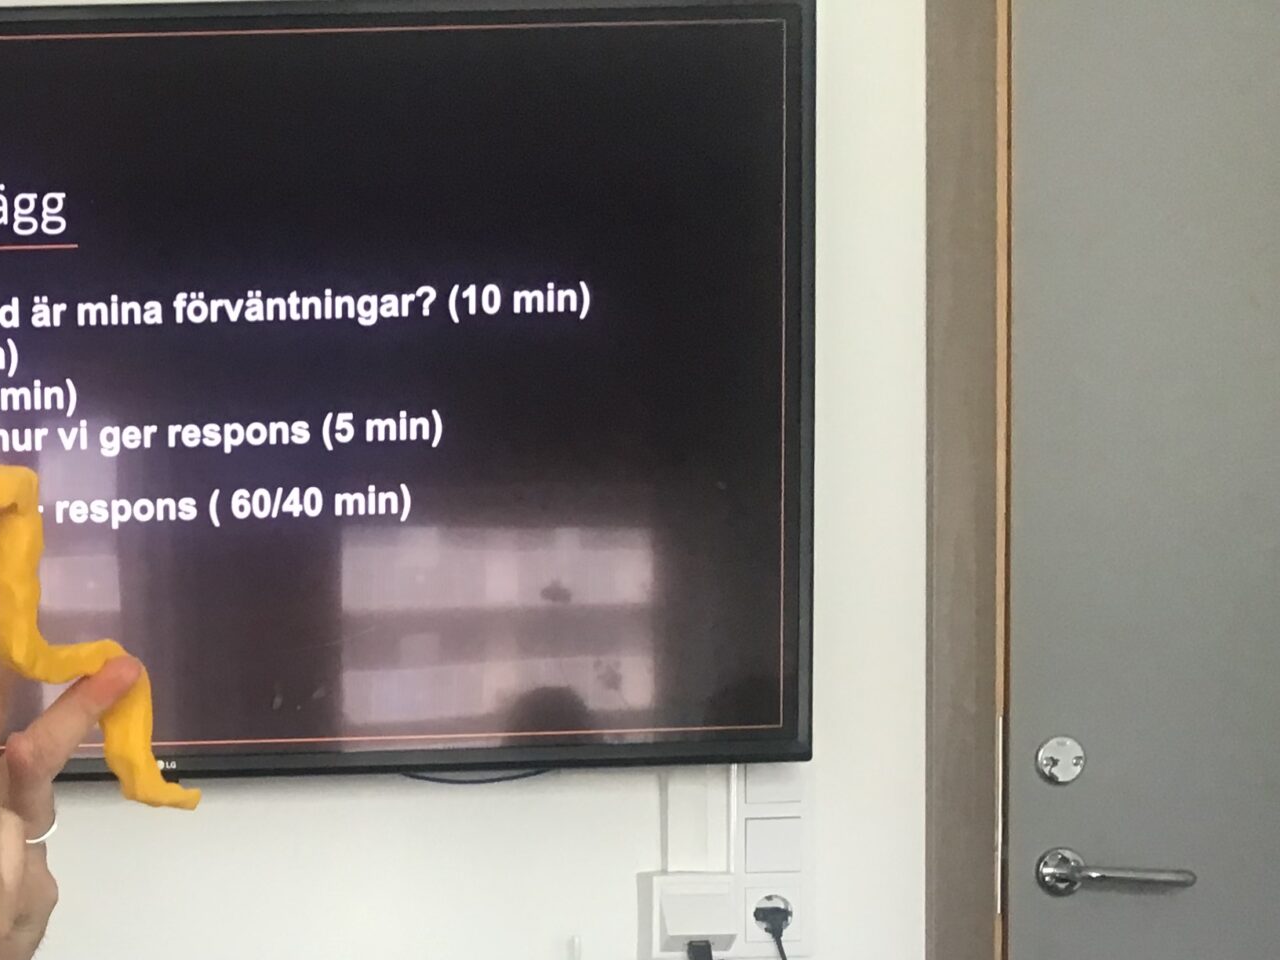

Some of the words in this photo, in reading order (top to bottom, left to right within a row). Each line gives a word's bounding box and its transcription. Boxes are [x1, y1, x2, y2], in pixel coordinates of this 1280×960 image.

[31, 295, 67, 328] är
[77, 294, 163, 326] mina
[173, 286, 437, 327] förväntningar?
[448, 285, 501, 323] (10
[513, 281, 591, 320] min)
[0, 378, 78, 417] min)
[57, 419, 88, 451] vi
[99, 424, 158, 458] ger
[168, 420, 311, 453] respons
[322, 412, 356, 450] (5
[366, 409, 444, 448] min)
[55, 497, 198, 530] respons
[231, 488, 324, 519] 60/40
[334, 485, 412, 522] min)
[165, 760, 177, 769] LG
